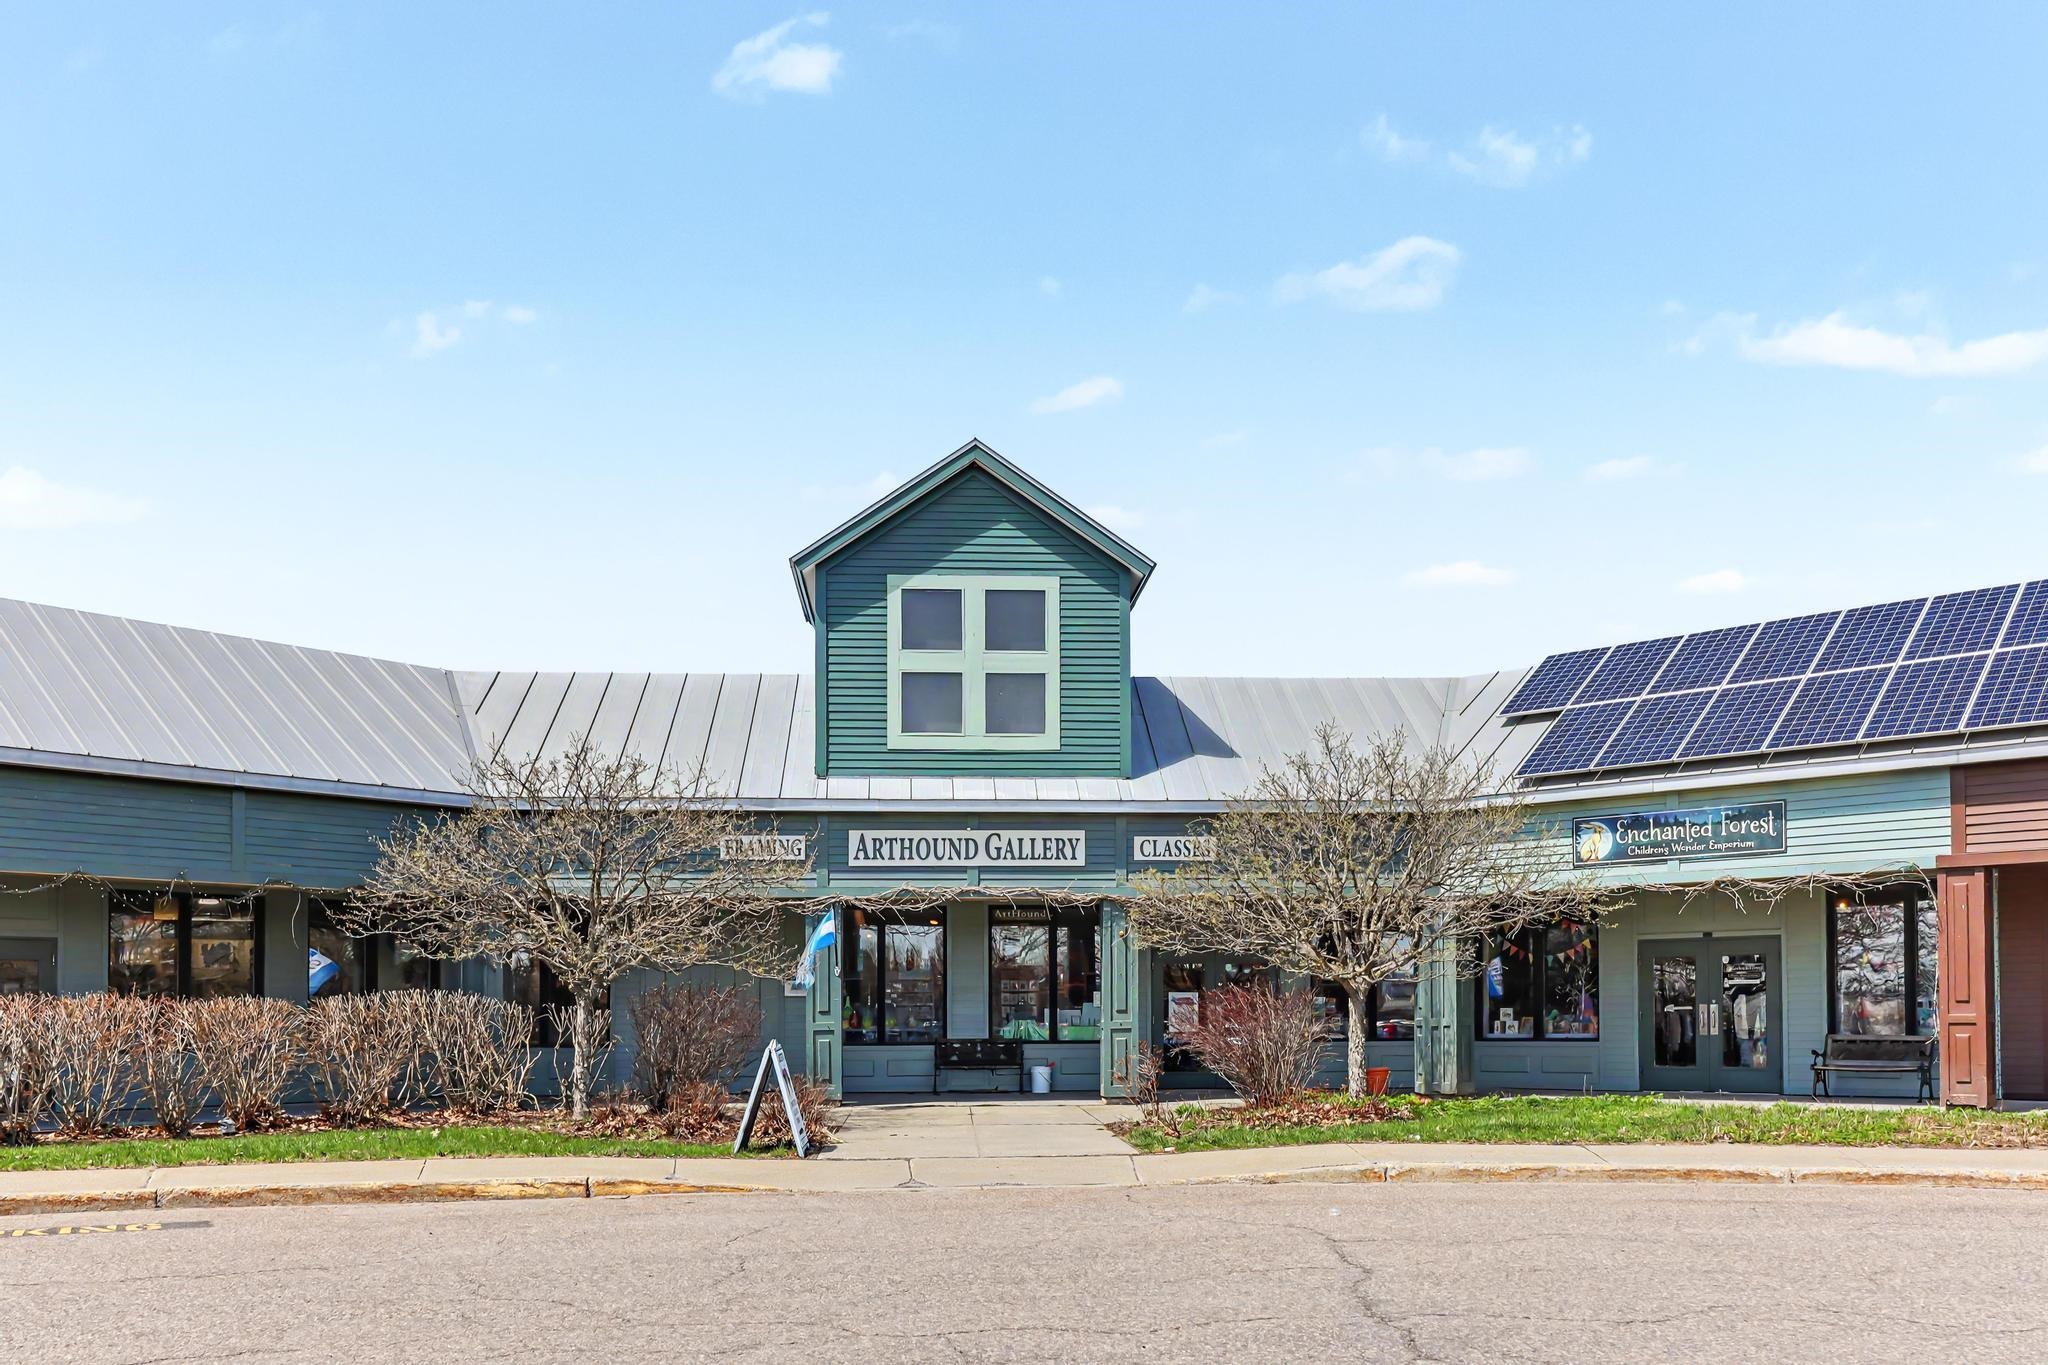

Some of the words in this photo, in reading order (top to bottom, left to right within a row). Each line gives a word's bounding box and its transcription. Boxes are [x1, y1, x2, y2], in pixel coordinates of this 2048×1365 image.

[1616, 815, 1712, 844] Enchanted
[1720, 810, 1777, 837] Forest
[1628, 843, 1669, 856] Children's
[0, 1223, 162, 1237] KING
